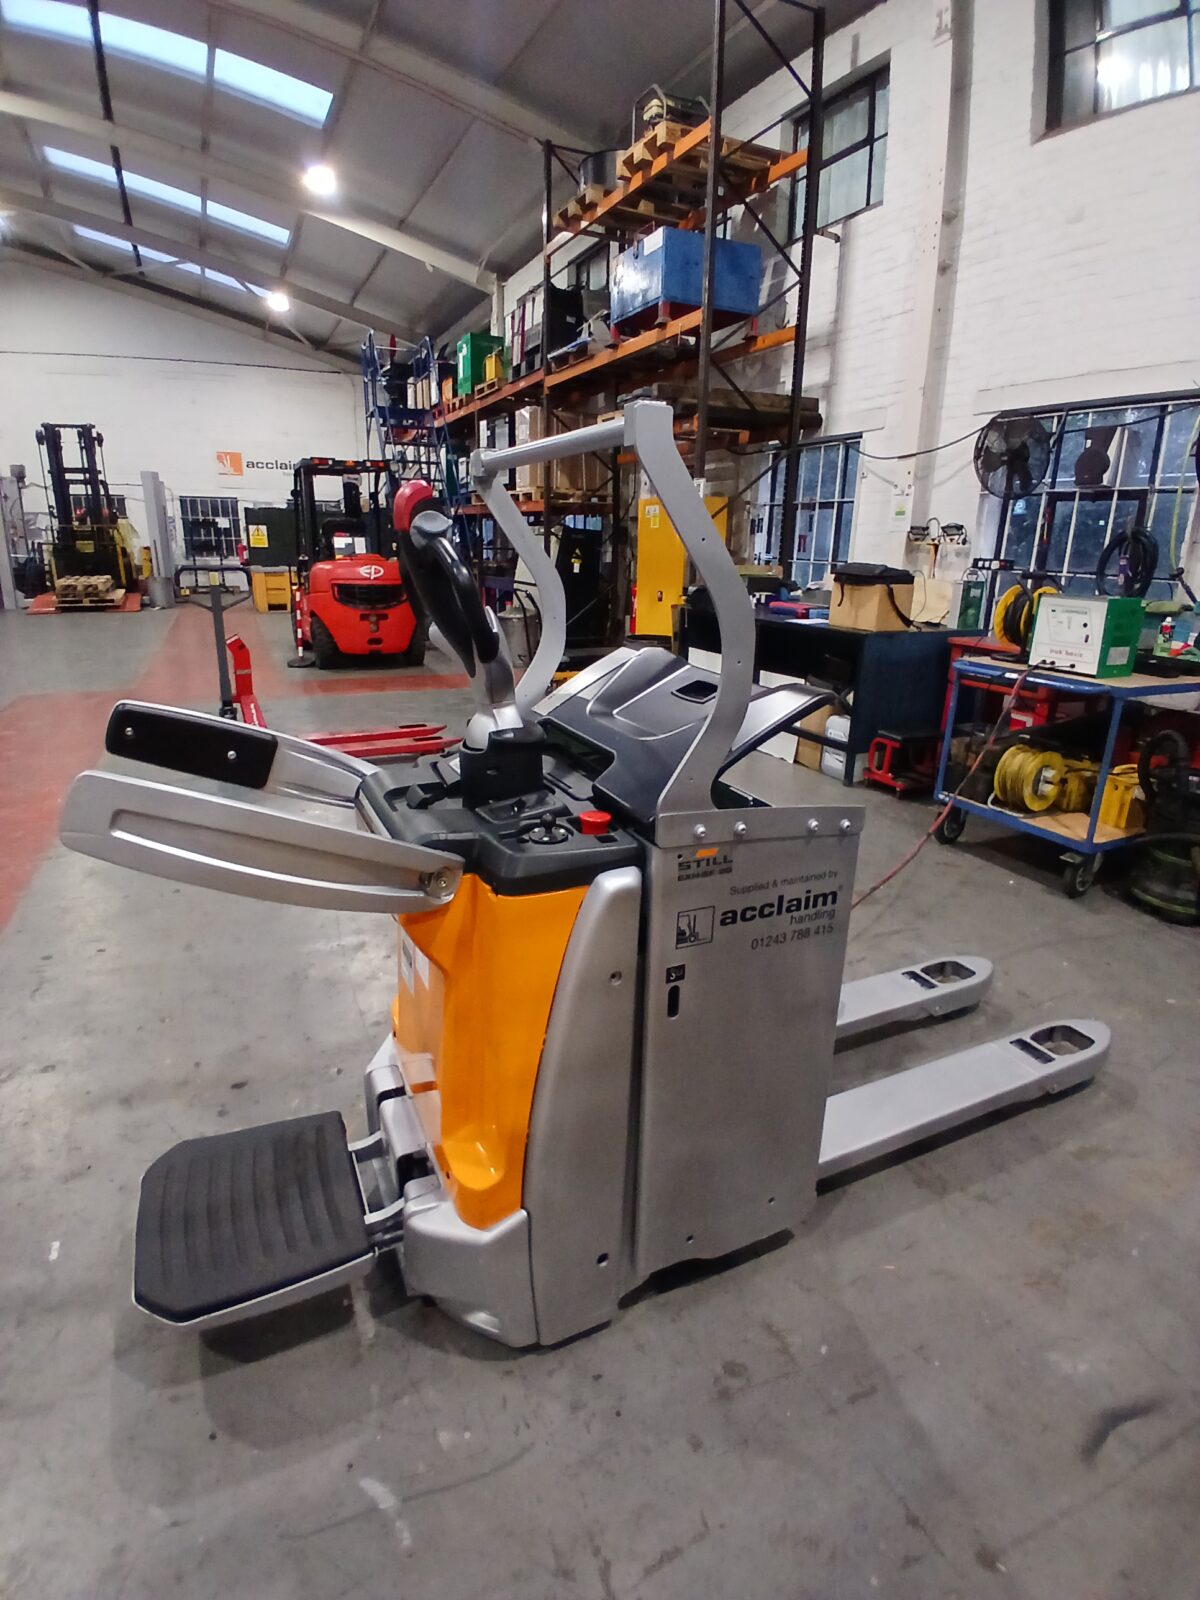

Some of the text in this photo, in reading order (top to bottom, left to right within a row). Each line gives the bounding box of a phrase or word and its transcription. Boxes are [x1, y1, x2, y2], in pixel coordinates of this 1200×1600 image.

[246, 460, 295, 470] acclai
[678, 854, 733, 871] STILL
[729, 870, 839, 895] Supplied & maintained by
[719, 889, 838, 926] acclaim
[789, 910, 836, 925] handling
[751, 923, 834, 950] 01243 788 415
